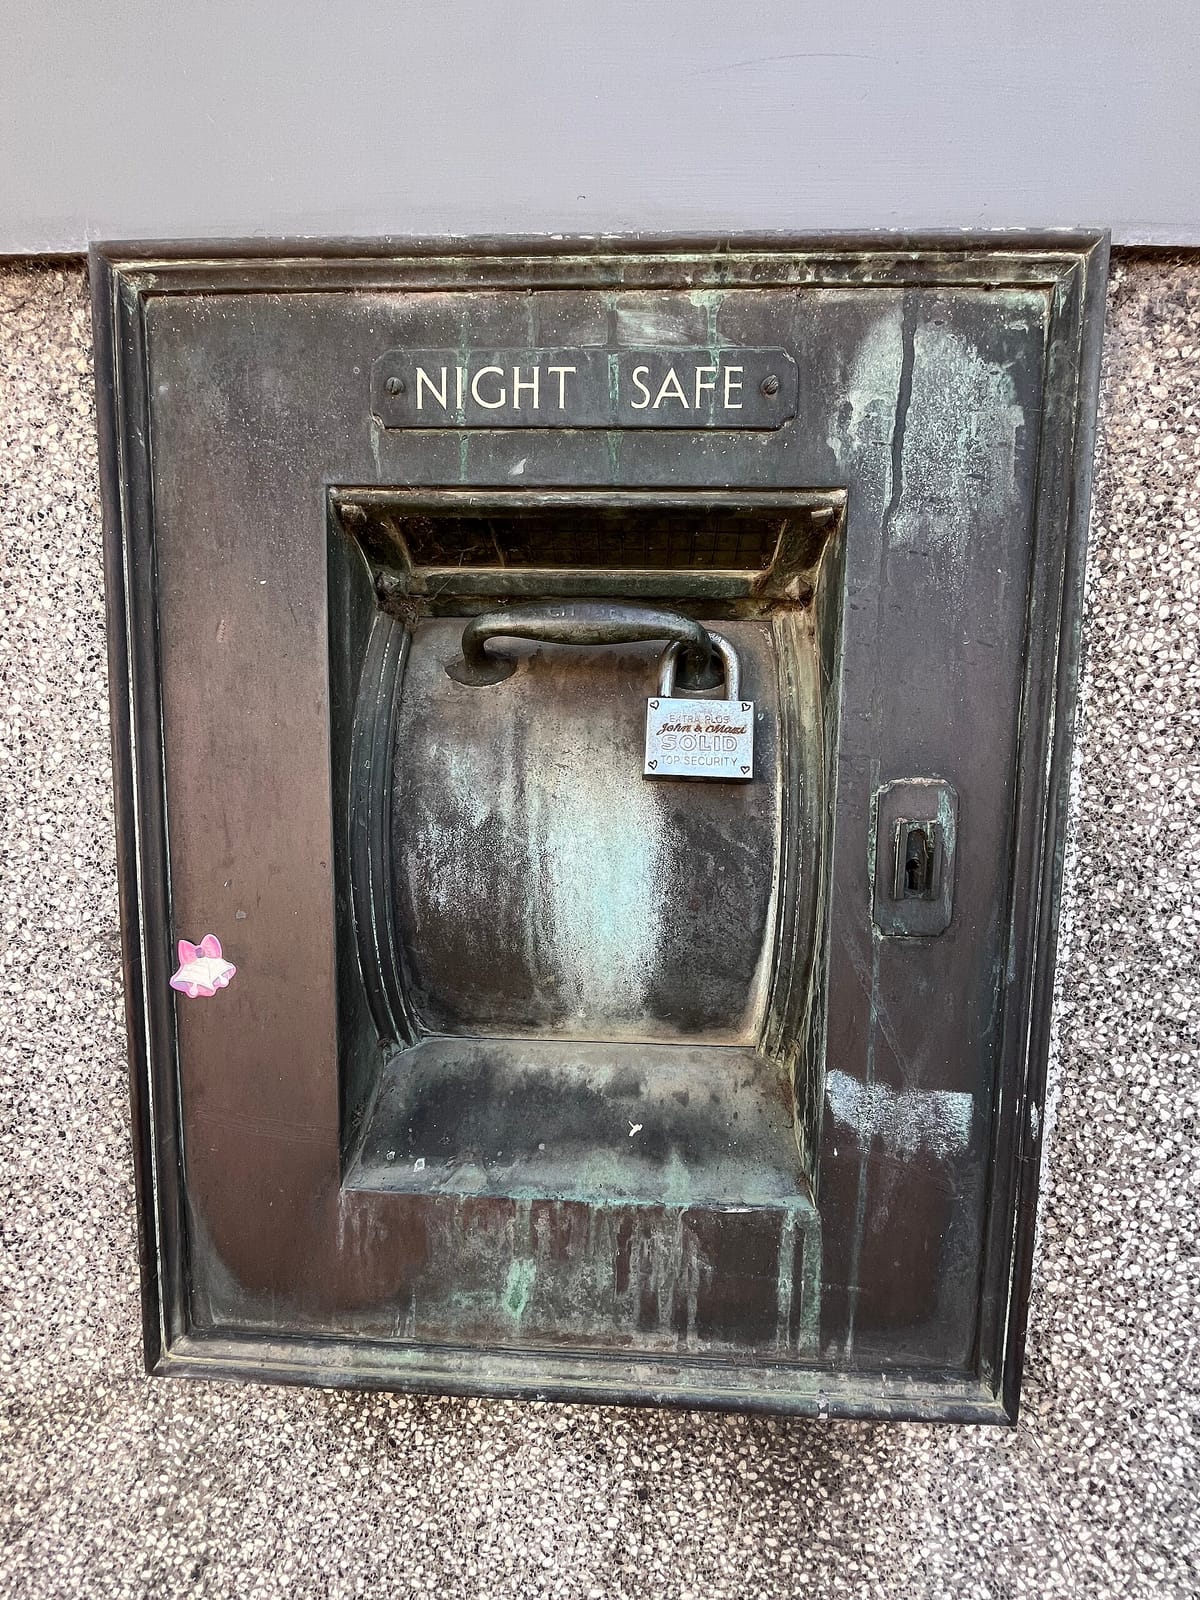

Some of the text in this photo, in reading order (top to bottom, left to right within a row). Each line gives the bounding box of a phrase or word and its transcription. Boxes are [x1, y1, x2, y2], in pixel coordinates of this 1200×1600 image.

[415, 365, 744, 411] NIGHT SAFE
[656, 722, 691, 736] John
[694, 724, 702, 733] &
[661, 734, 738, 752] SOLID
[661, 755, 738, 766] TOP SECURITY
